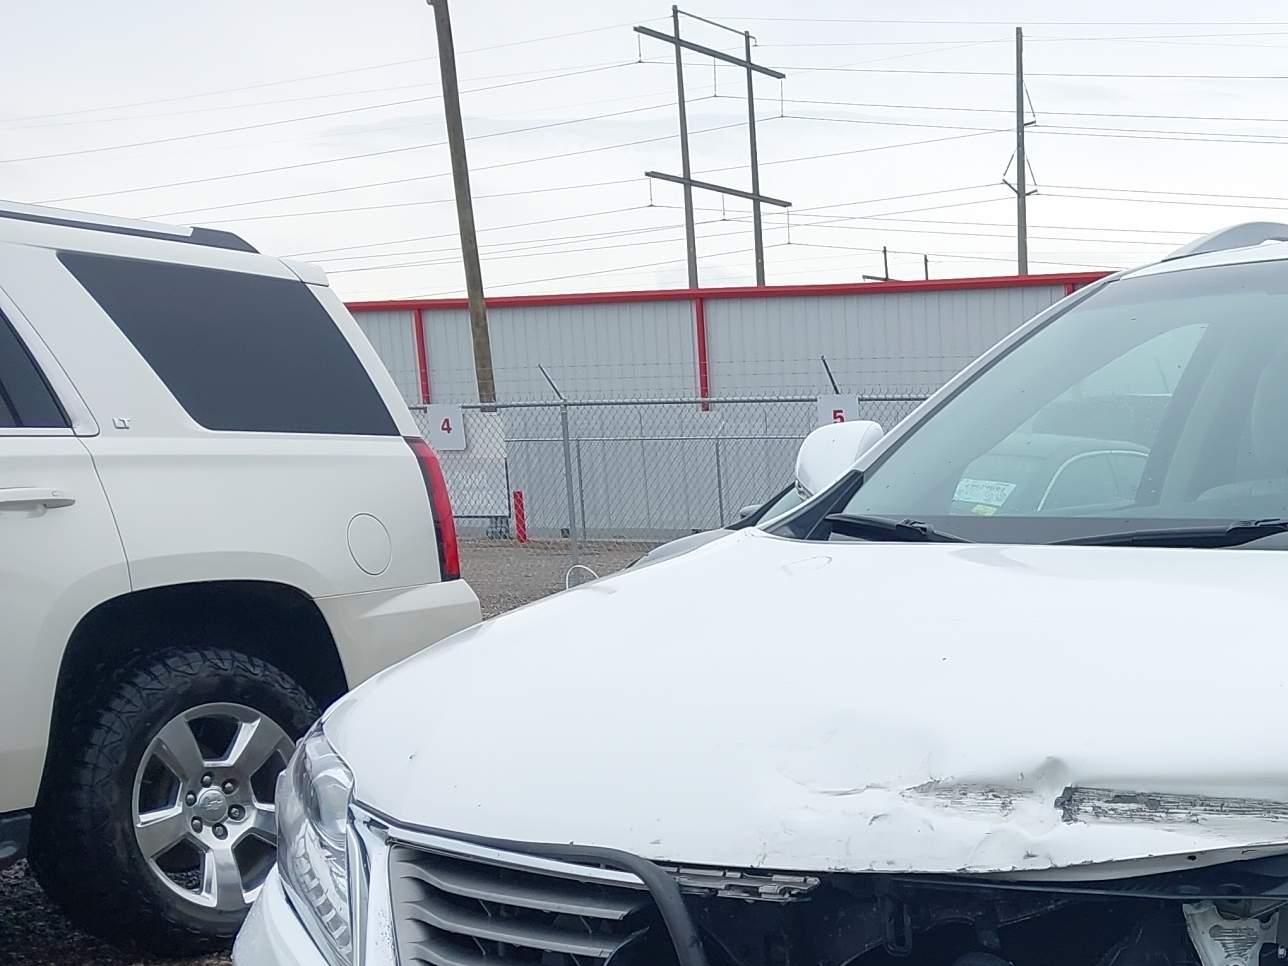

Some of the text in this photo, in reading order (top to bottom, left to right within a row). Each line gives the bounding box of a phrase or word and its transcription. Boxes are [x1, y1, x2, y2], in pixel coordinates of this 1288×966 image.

[112, 417, 130, 430] LT
[832, 409, 845, 424] 5
[441, 418, 452, 434] 4
